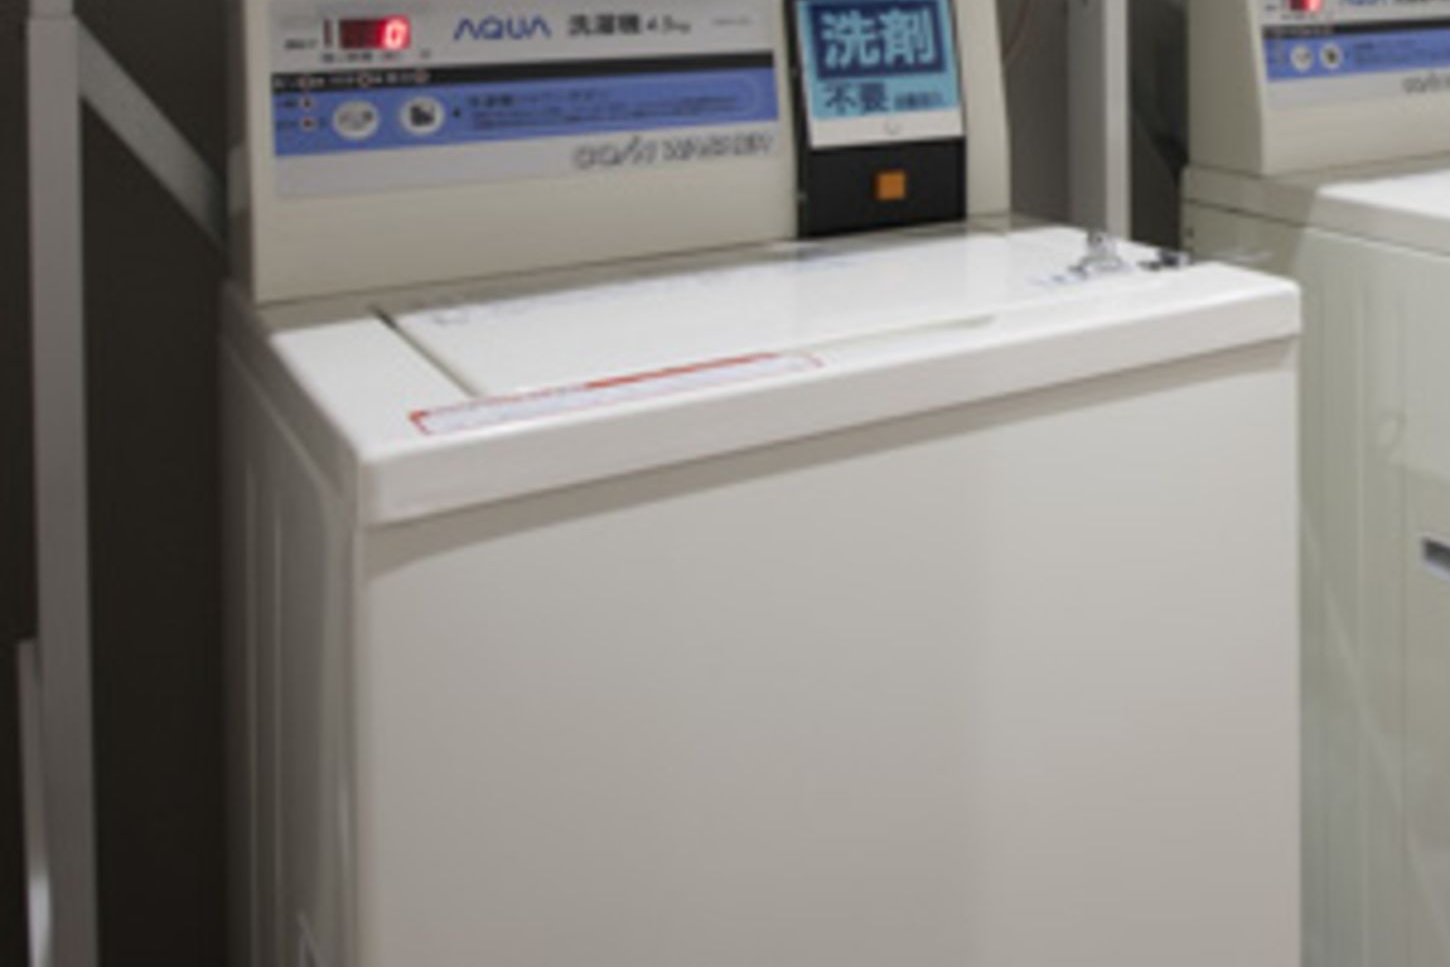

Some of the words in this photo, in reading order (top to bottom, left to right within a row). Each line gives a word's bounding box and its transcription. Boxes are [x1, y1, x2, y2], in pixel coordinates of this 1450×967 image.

[382, 18, 410, 50] 0
[453, 14, 552, 41] AQUA
[568, 12, 642, 37] 洗濯機
[820, 7, 936, 68] 洗剤
[821, 82, 889, 116] 不要
